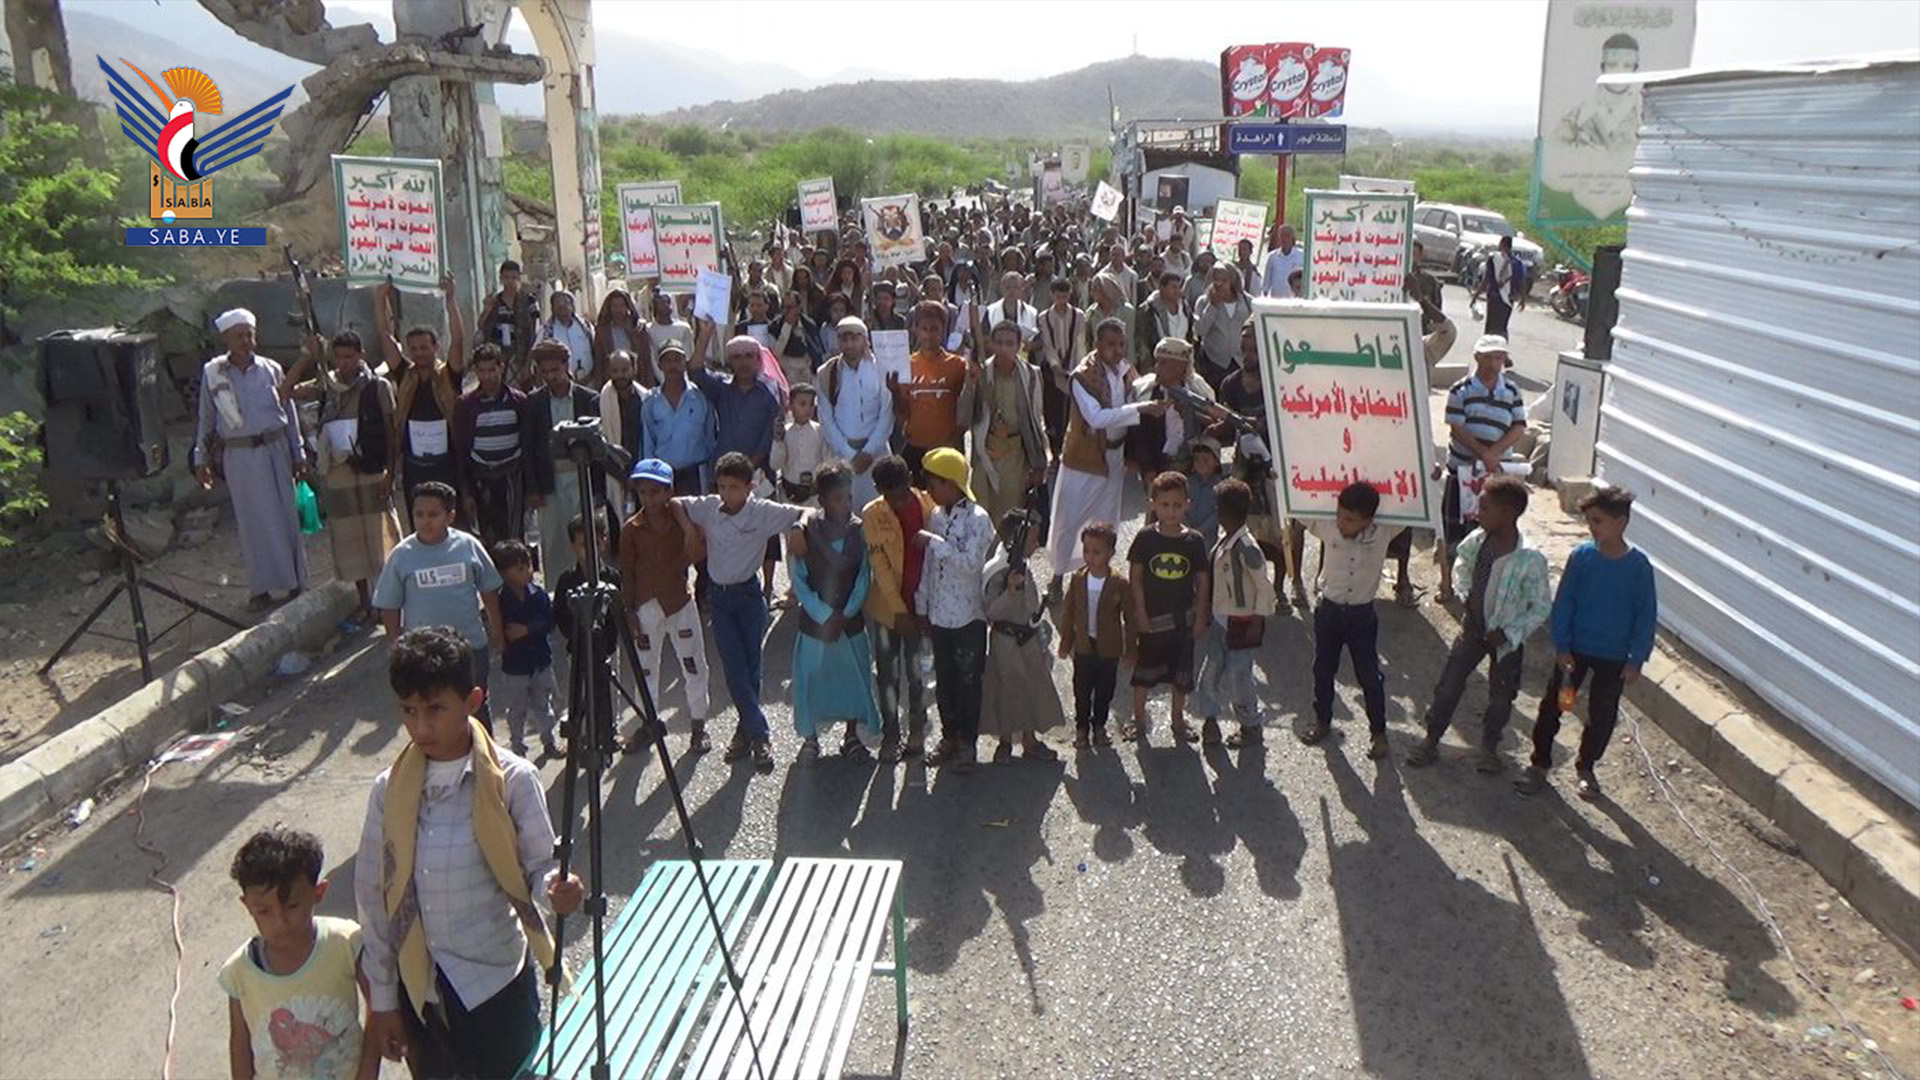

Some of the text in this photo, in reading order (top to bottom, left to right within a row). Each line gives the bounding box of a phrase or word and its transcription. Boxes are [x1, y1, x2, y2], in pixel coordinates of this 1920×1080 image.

[1271, 69, 1306, 92] Crystal
[1311, 71, 1344, 93] Crystal
[1236, 132, 1275, 144] الراهدة
[348, 169, 433, 193] الله أكبر
[398, 201, 433, 216] الموت
[1316, 200, 1405, 228] الله أكبر
[399, 220, 436, 236] الموت
[655, 211, 712, 229] قاطعوا
[350, 236, 437, 254] اللعنة على اليهود
[1365, 231, 1404, 247] الموت
[684, 248, 690, 260] و
[1362, 252, 1402, 268] الموت
[398, 257, 437, 276] النصر
[1311, 270, 1402, 287] اللعنة على اليهود
[1272, 331, 1404, 374] قاطعوا
[1280, 381, 1408, 425] البضائع الأمريكية
[1343, 427, 1352, 453] و
[1291, 464, 1418, 502] الإسائيلية
